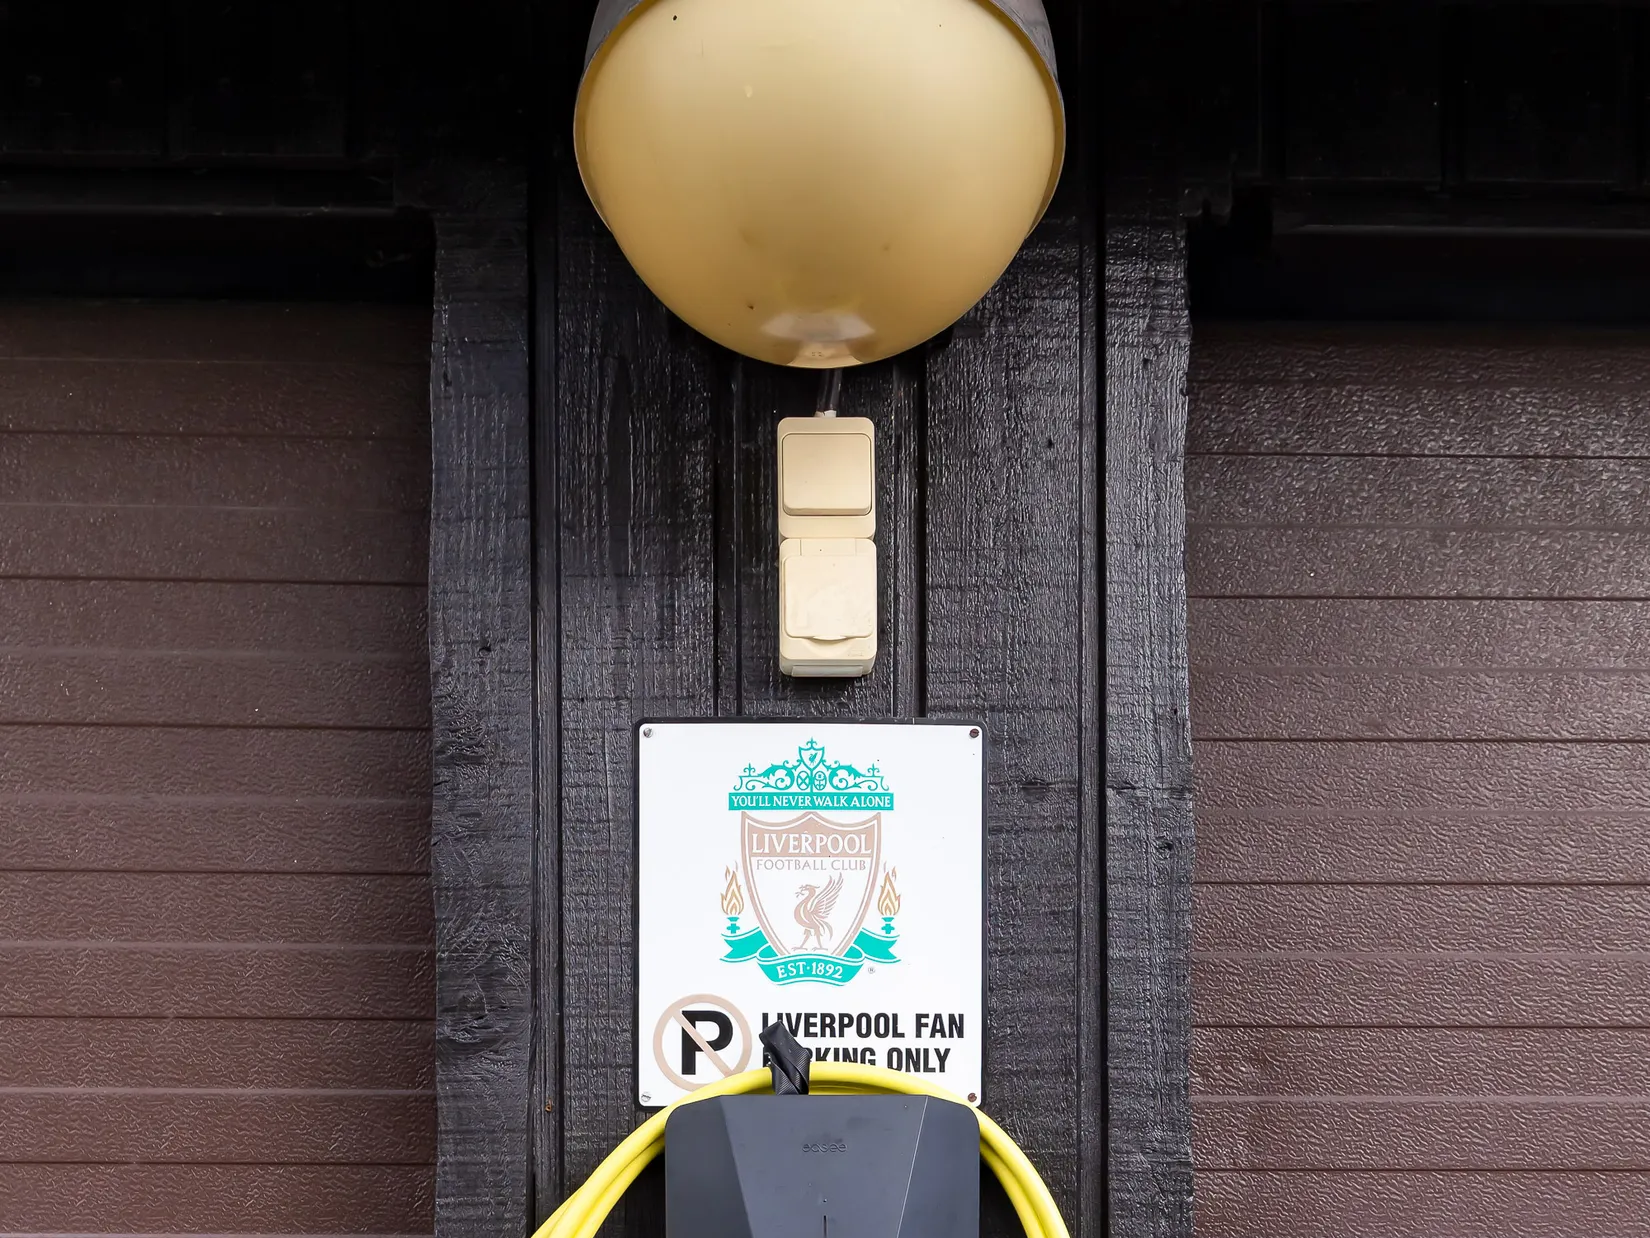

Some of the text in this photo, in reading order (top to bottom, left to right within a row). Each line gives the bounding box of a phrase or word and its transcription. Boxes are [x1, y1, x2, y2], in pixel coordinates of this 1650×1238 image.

[731, 795, 891, 808] YOU'LL NEVER WALK ALONE
[752, 833, 871, 854] LIVERPOOL
[756, 859, 866, 871] FOOTBALL CLUB
[915, 1013, 964, 1038] FAN
[887, 1047, 951, 1073] ONLY
